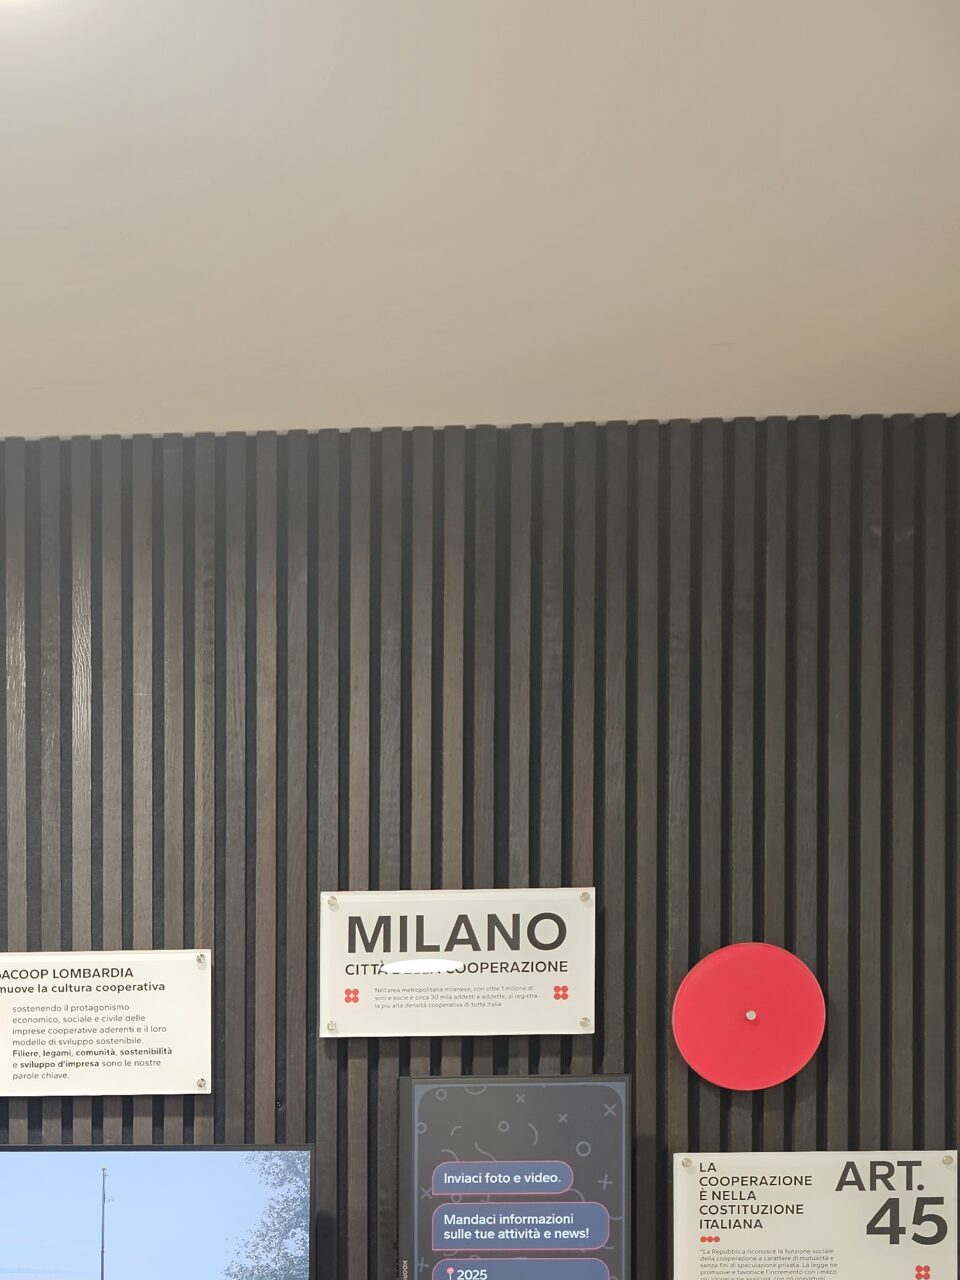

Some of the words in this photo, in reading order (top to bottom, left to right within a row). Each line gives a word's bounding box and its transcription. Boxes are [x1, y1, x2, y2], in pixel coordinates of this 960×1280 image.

[348, 912, 567, 953] MILANO
[446, 960, 569, 974] OOPERAZIONE
[53, 968, 133, 979] LOMBARDIA
[38, 984, 48, 993] la
[51, 983, 92, 992] cultura
[96, 981, 165, 994] cooperativa
[43, 1049, 73, 1058] legami,
[76, 1048, 117, 1056] comunità,
[120, 1047, 172, 1055] sostenibilità
[13, 1072, 39, 1080] parole
[700, 1162, 717, 1172] LA
[444, 1173, 482, 1183] Inviaci
[484, 1172, 510, 1183] foto
[513, 1175, 521, 1183] e
[524, 1172, 560, 1183] video.
[699, 1176, 812, 1186] COOPERAZIONE
[835, 1160, 924, 1191] ART.
[700, 1188, 707, 1200] È
[712, 1190, 756, 1200] NELLA
[699, 1204, 804, 1215] COSTITUZIONE
[444, 1214, 496, 1225] Mandaci
[499, 1213, 573, 1224] informazioni
[700, 1219, 763, 1229] ITALIANA
[866, 1197, 948, 1245] 45
[444, 1229, 472, 1239] sulle
[474, 1229, 495, 1239] tue
[498, 1228, 540, 1239] attività
[544, 1230, 551, 1239] e
[554, 1228, 589, 1239] news!
[457, 1269, 487, 1280] 2025
